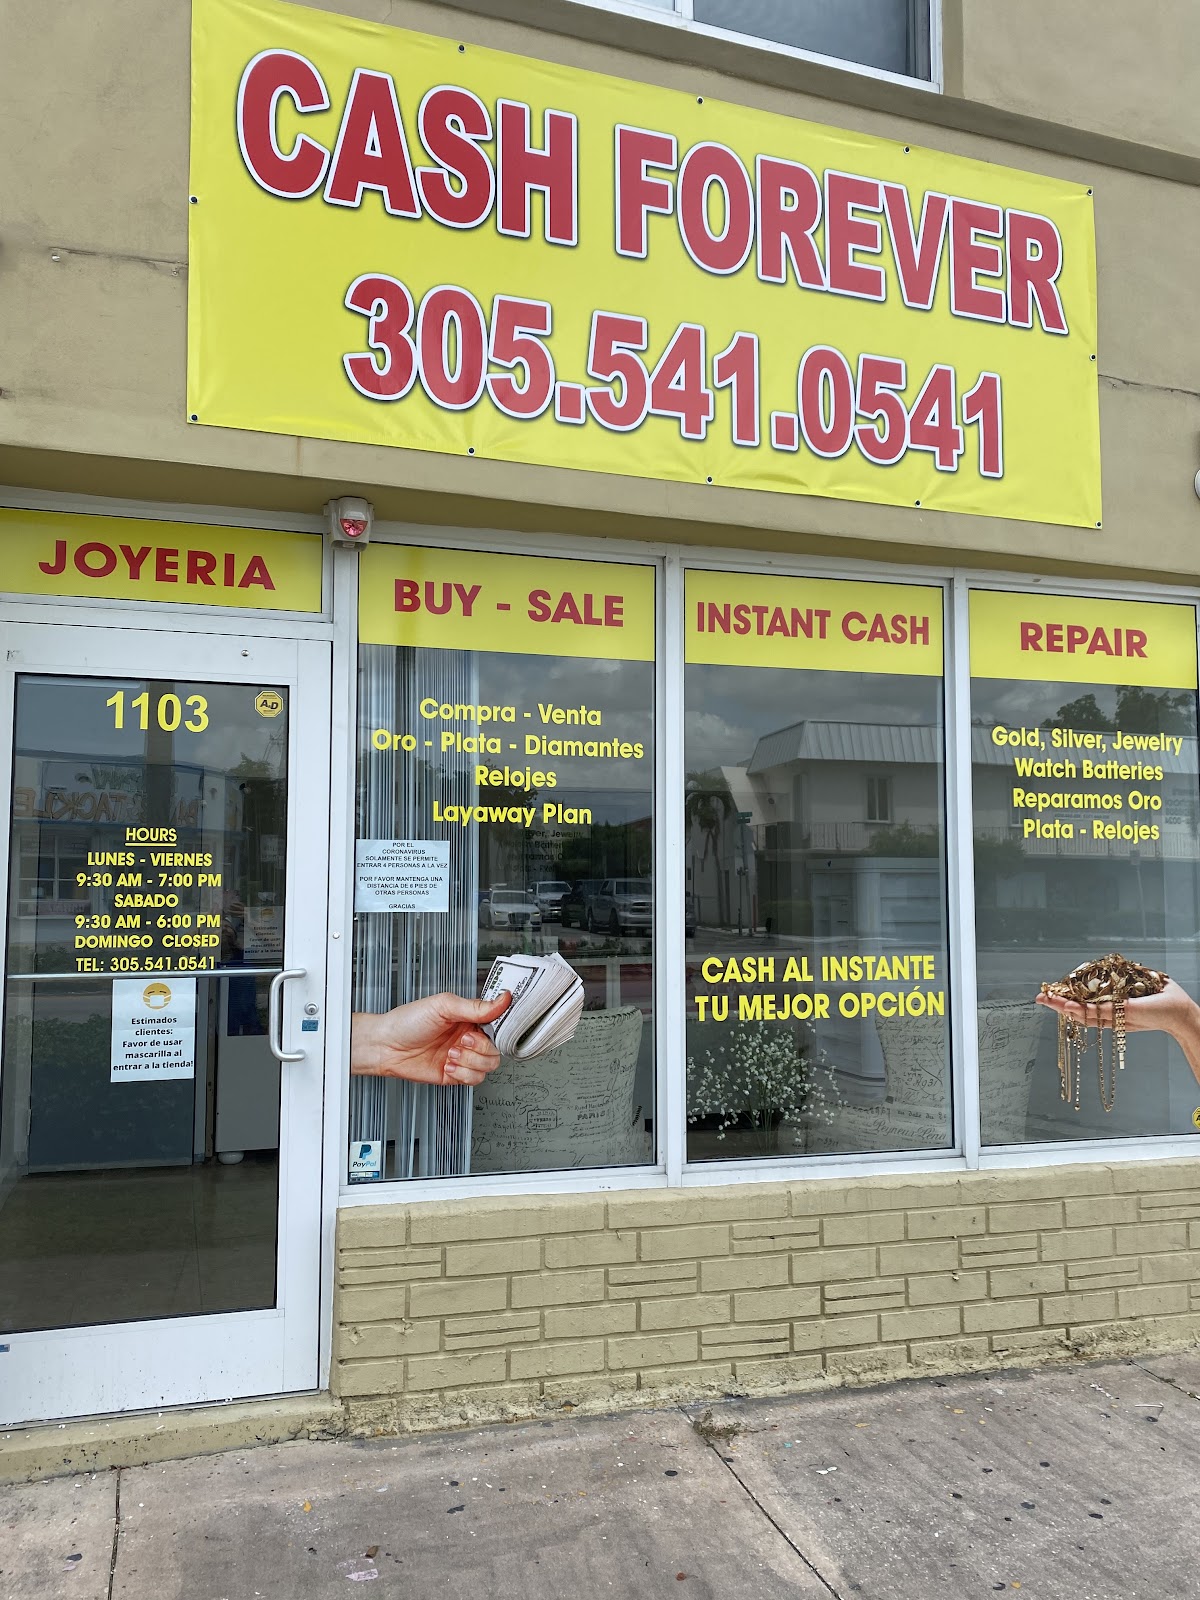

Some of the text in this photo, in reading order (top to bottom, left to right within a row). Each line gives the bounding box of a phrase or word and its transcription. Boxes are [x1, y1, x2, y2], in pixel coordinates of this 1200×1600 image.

[238, 51, 1068, 335] CASH FOREVER
[344, 272, 1003, 478] 305.541.0541
[40, 541, 274, 589] JOYERIA
[395, 579, 483, 617] BUY
[528, 590, 623, 626] SALE
[697, 602, 929, 645] INSTANT CASH
[1020, 622, 1148, 658] REPAIR
[105, 689, 210, 734] 1103
[419, 697, 516, 725] Compra
[537, 702, 602, 727] Venta
[371, 729, 417, 752] Oro
[441, 731, 502, 754] Plata
[526, 734, 645, 759] Diamantes
[991, 725, 1183, 756] Gold, Silver, Jewelry
[474, 764, 557, 792] Relojes
[1014, 758, 1163, 781] Watch Batteries
[1012, 787, 1121, 812] Reparamos
[1127, 790, 1163, 811] Oro
[432, 800, 592, 827] Layaway Plan
[125, 827, 177, 842] HOURS
[1023, 818, 1074, 839] Plata
[1092, 819, 1159, 844] Relojes
[87, 851, 135, 867] LUNES
[150, 852, 213, 867] VIERNES
[356, 861, 382, 869] ENTRAR
[76, 872, 113, 887] 9:30
[116, 872, 143, 887] AM
[159, 873, 193, 888] 7:00
[197, 873, 222, 887] PM
[115, 893, 179, 908] SABADO
[75, 914, 111, 929] 9:30
[115, 914, 141, 929] AM
[156, 913, 192, 929] 6:00
[196, 914, 221, 928] PM
[74, 934, 220, 949] DOMINGO CLOSED
[75, 955, 216, 973] TEL: 305.541.0541
[701, 954, 936, 984] CASH AL INSTANTE
[694, 985, 946, 1022] TU MEJOR OPCIÓN
[135, 1027, 173, 1036] clientes:
[163, 1039, 184, 1047] usar
[125, 1049, 183, 1059] mascarilla al
[162, 1060, 193, 1068] tienda!
[352, 1160, 377, 1168] PayPal
